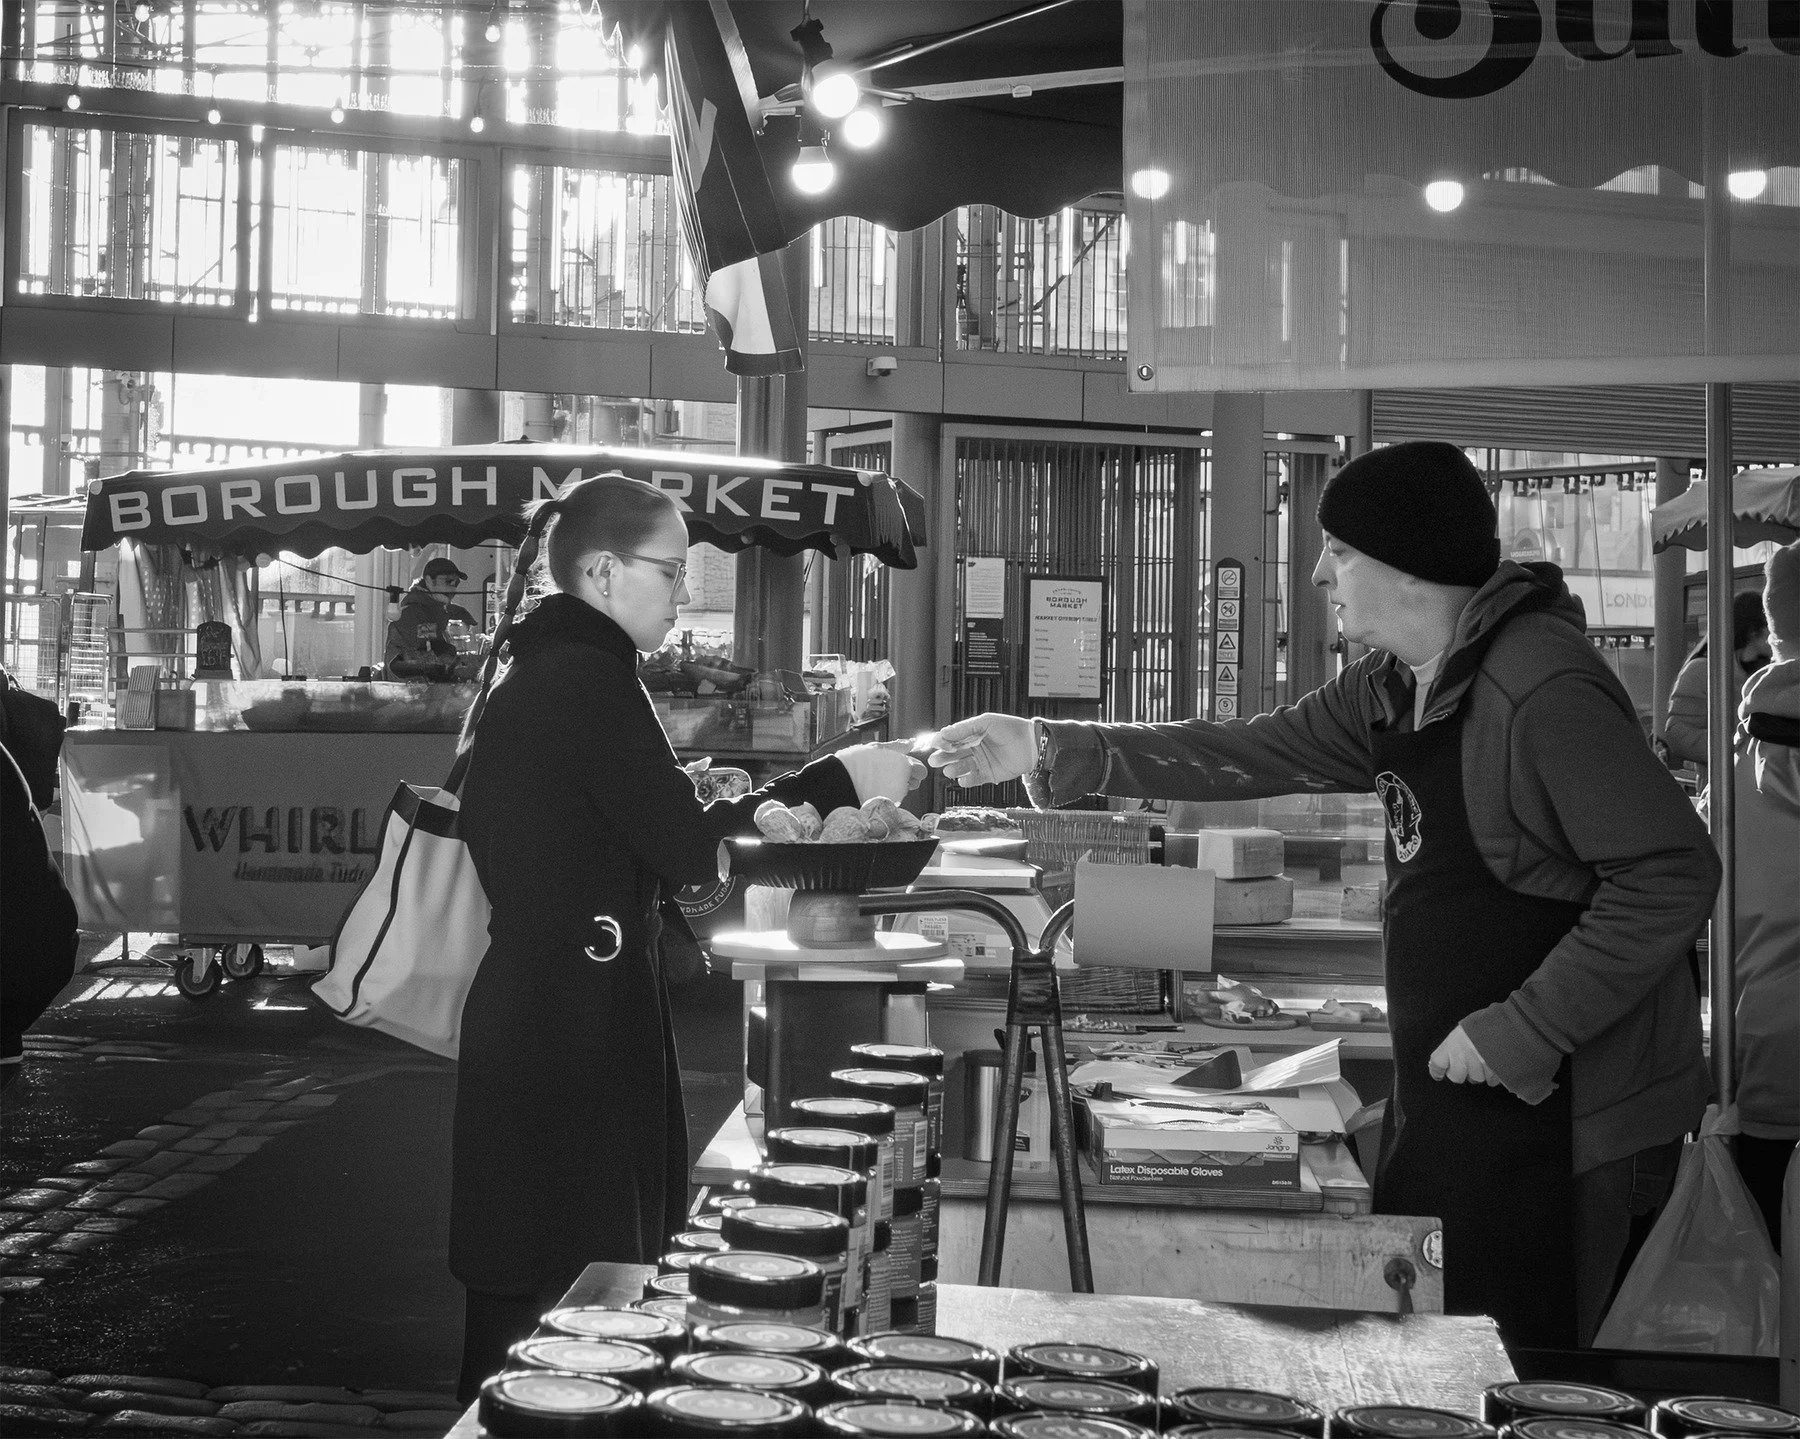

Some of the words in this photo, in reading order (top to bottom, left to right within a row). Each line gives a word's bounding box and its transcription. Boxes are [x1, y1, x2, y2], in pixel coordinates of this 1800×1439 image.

[108, 466, 497, 533] BOROUGH
[532, 466, 855, 525] MRKET
[1265, 1143, 1291, 1152] Jangro
[1110, 1164, 1135, 1175] Latex
[1137, 1165, 1189, 1178] Disposable
[1191, 1166, 1223, 1177] Gloves
